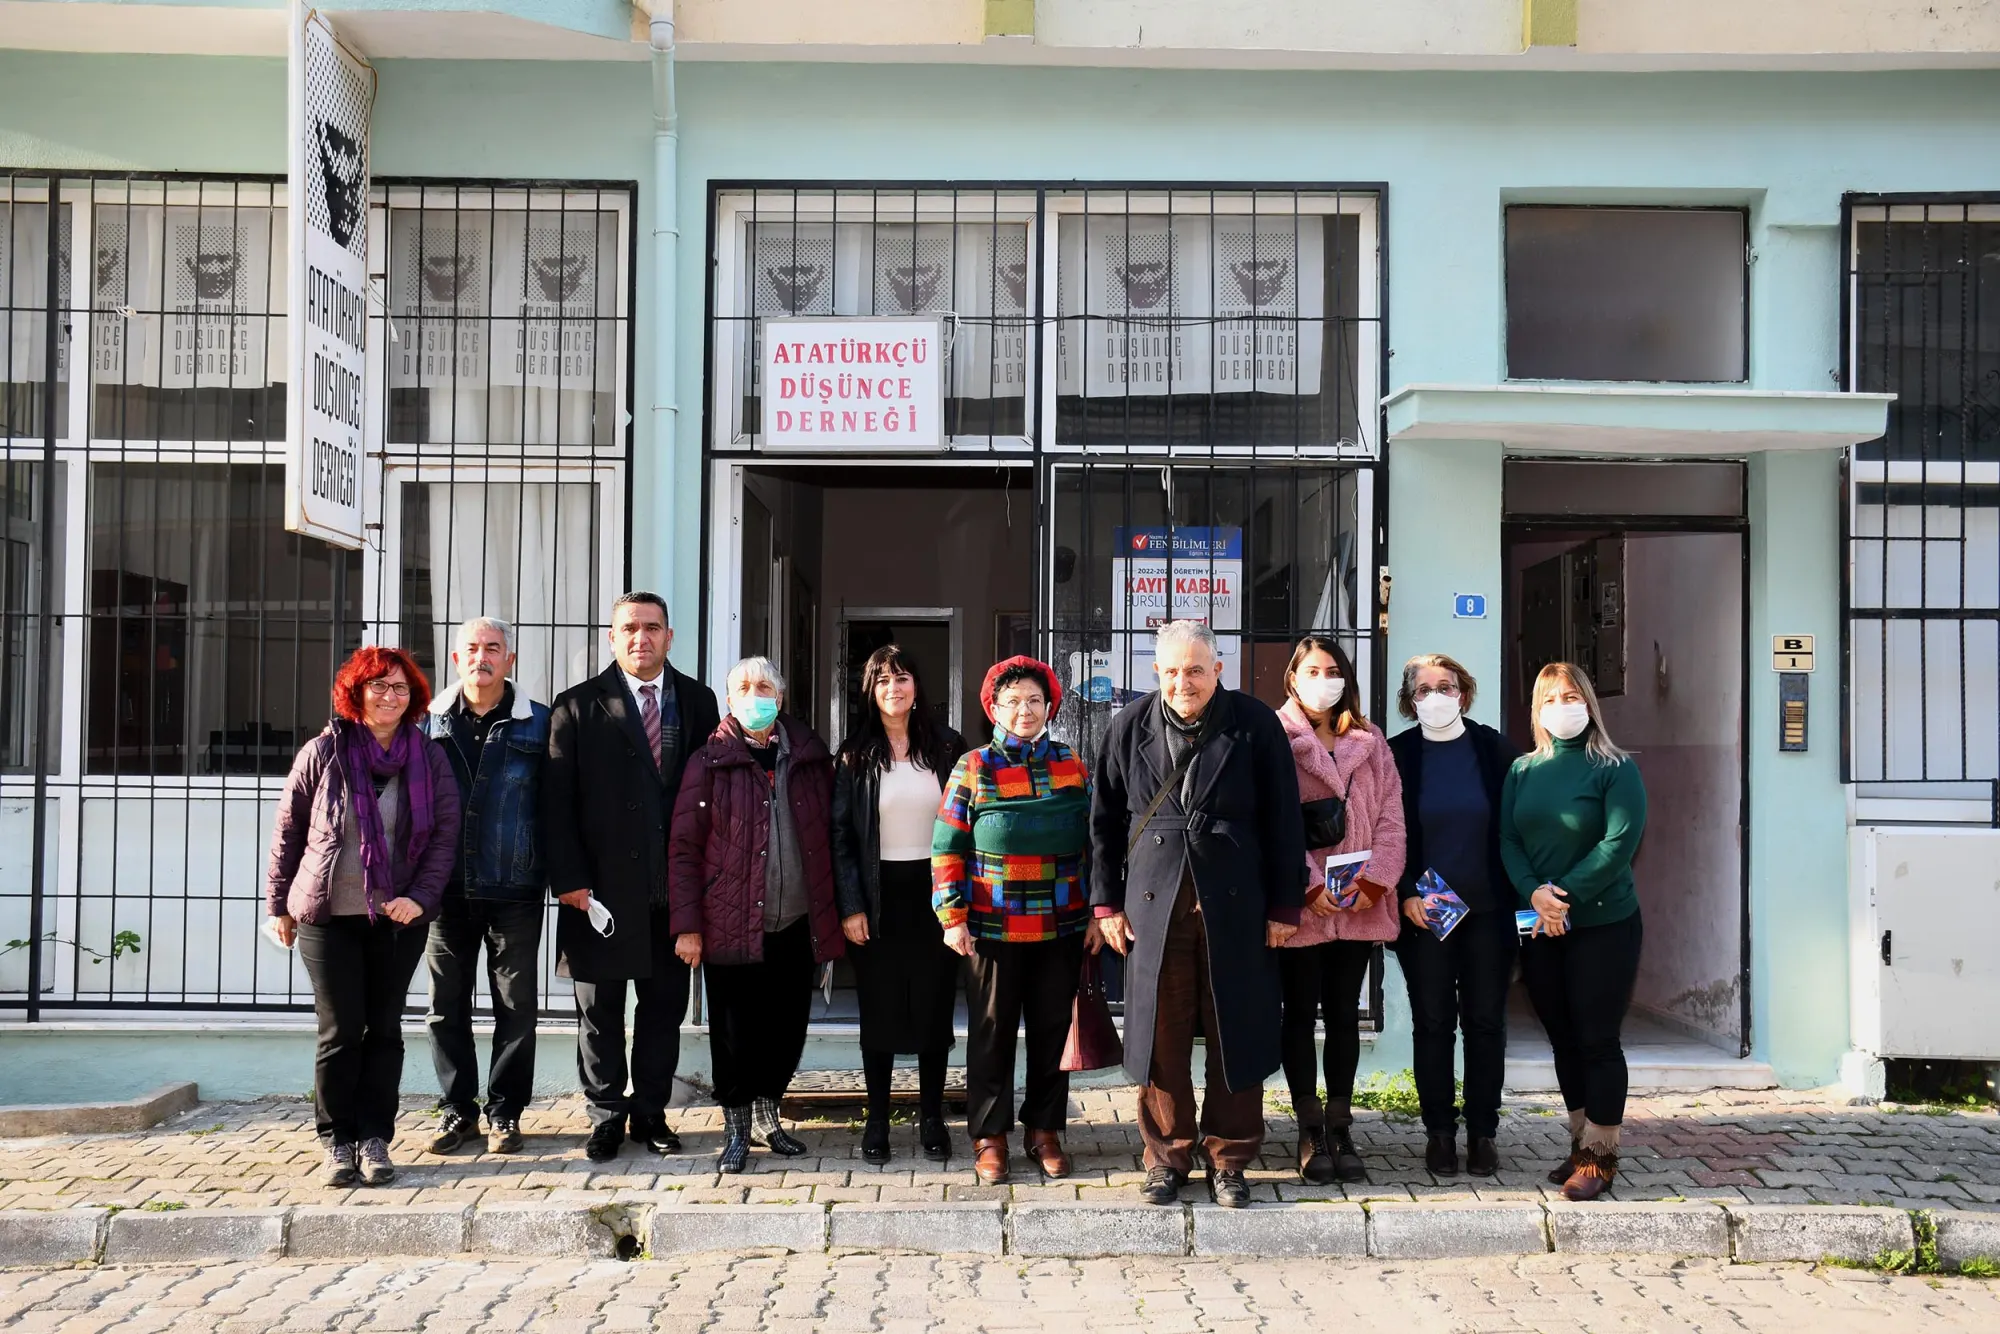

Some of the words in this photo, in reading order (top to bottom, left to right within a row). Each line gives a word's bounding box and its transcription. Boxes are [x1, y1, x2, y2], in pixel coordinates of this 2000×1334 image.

[309, 264, 365, 355] ATATÜRKÇÜ
[405, 327, 479, 353] DŞÜCE
[517, 327, 592, 352] DÜŞÜNCE
[1220, 331, 1294, 356] DÜŞÜNCE
[516, 353, 591, 377] DERNEĞİ
[774, 338, 927, 367] ATATÜRKÇÜ
[404, 354, 478, 378] DRNĞİ
[1108, 358, 1182, 383] DERNEİ
[1220, 357, 1294, 381] DERNEĞİ
[313, 343, 360, 430] DÜŞÜNCE
[780, 373, 912, 404] DÜŞÜNCE
[776, 405, 917, 432] DERNEĞİ
[312, 436, 357, 509] DERNEĞİ
[1149, 541, 1168, 549] FEN
[1176, 578, 1230, 594] KABUL
[1467, 598, 1474, 613] 8
[1784, 639, 1803, 650] B
[1789, 657, 1797, 667] 1
